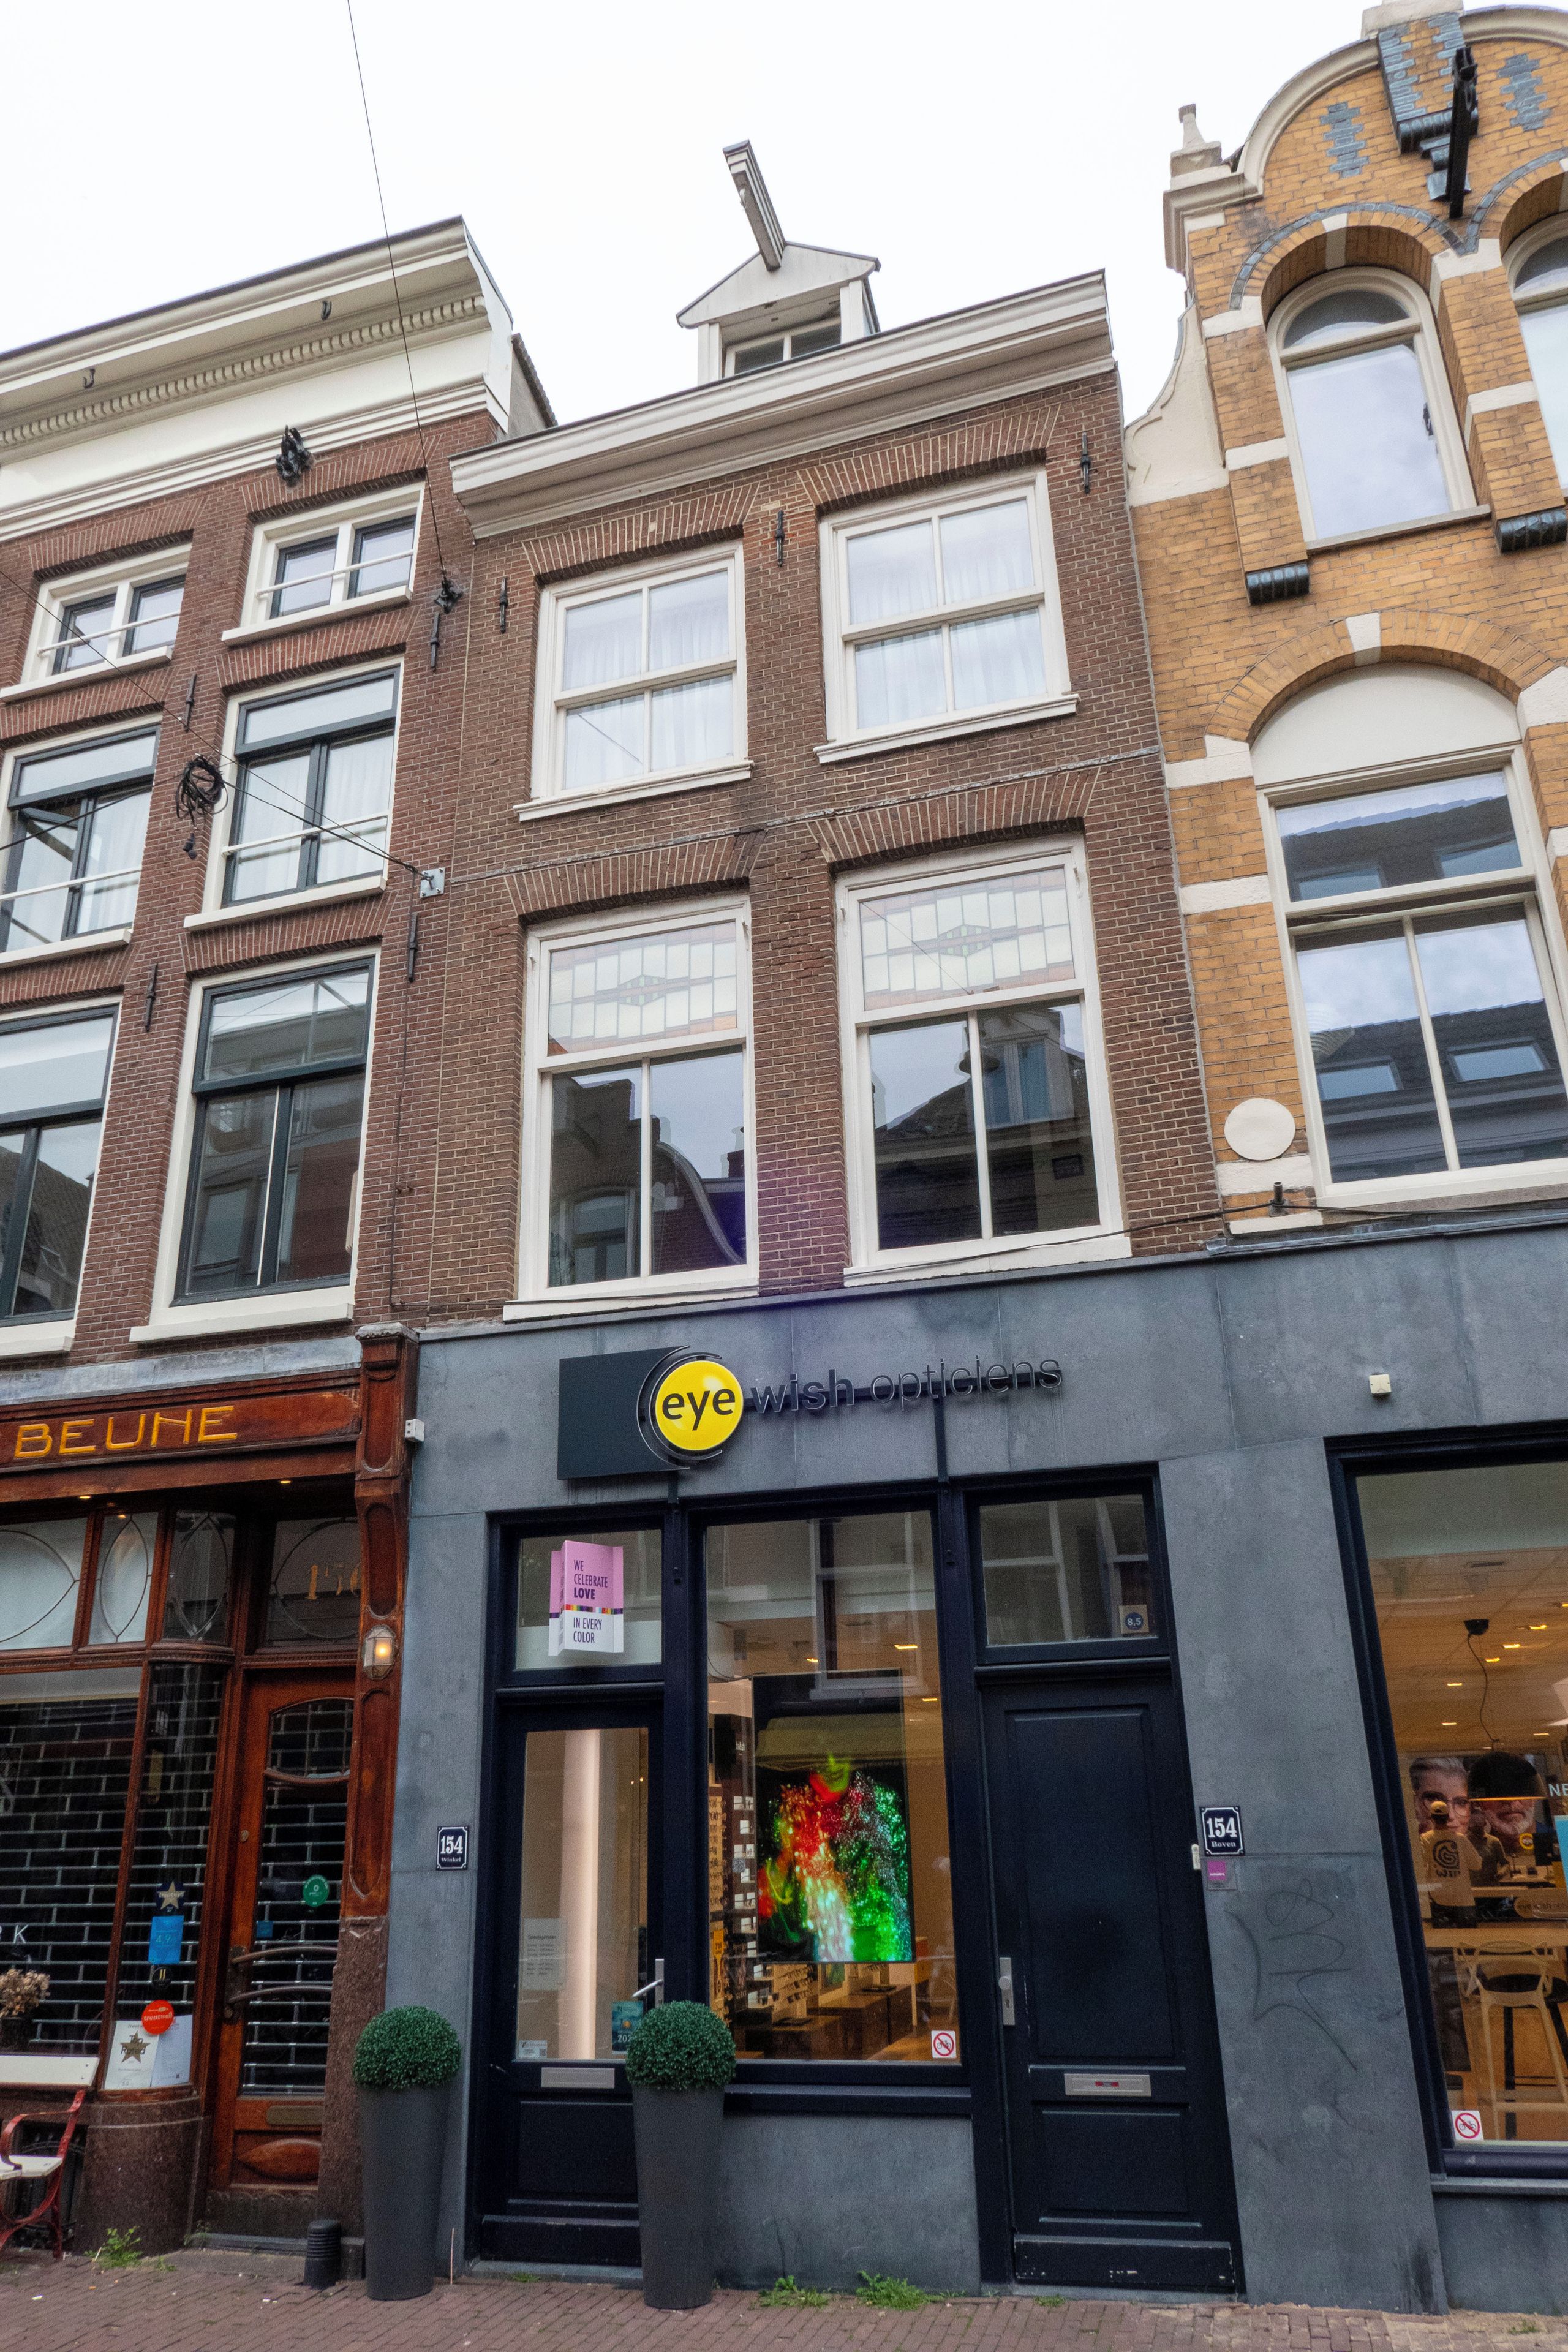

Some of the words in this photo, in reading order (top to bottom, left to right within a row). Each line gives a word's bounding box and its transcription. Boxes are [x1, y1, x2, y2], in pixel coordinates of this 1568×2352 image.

[662, 1388, 736, 1431] eye
[750, 1369, 855, 1414] wish
[870, 1355, 1062, 1411] opticiens
[14, 1405, 238, 1459] BEUNE
[574, 1560, 584, 1572] WE
[574, 1574, 608, 1588] CELEBRATE
[573, 1587, 595, 1600] LOVE
[573, 1617, 581, 1629] IN
[582, 1619, 603, 1630] EVERY
[1127, 1618, 1142, 1627] 8,5
[573, 1631, 595, 1644] COLOR
[1206, 1817, 1237, 1838] 154
[440, 1835, 463, 1855] 154
